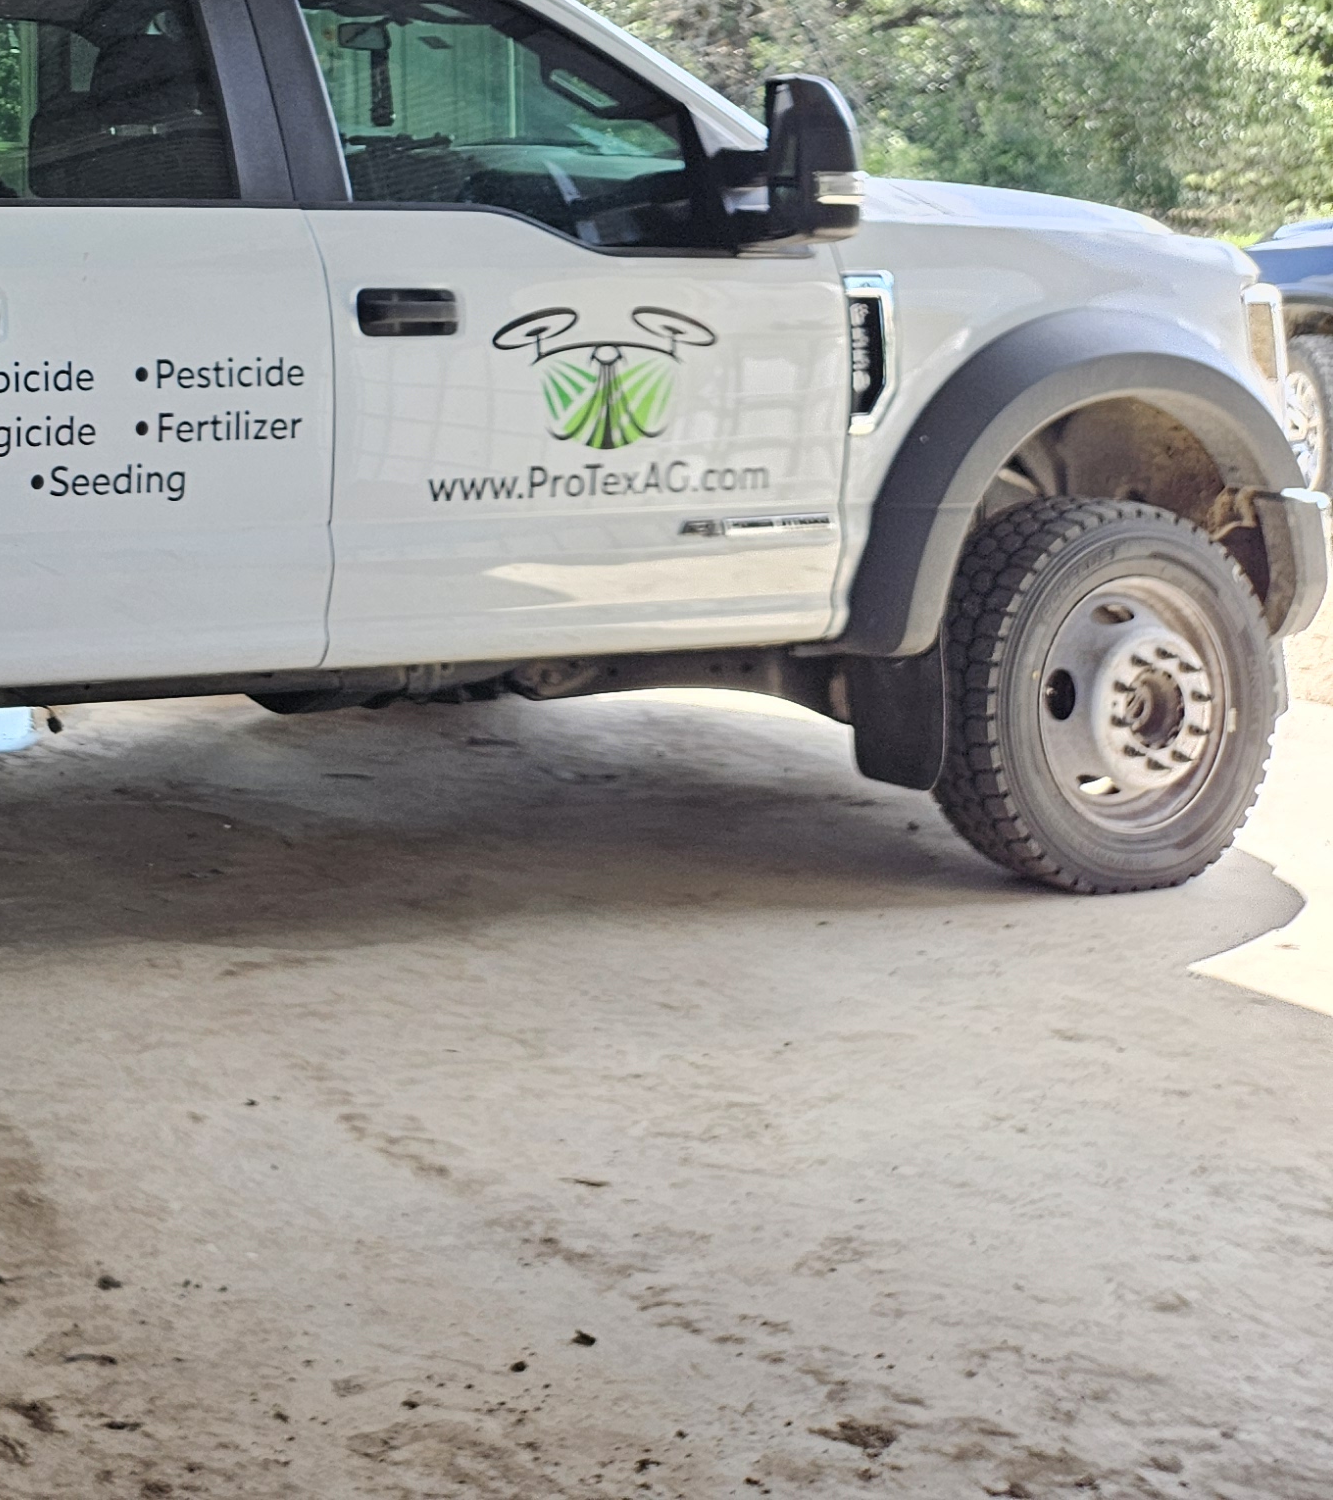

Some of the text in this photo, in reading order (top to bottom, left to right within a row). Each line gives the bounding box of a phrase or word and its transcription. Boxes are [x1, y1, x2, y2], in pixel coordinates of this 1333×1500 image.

[156, 357, 305, 389] Pesticide
[158, 410, 303, 443] Fertilizer
[49, 463, 186, 501] Seeding
[428, 461, 770, 501] www.ProTexAG.com
